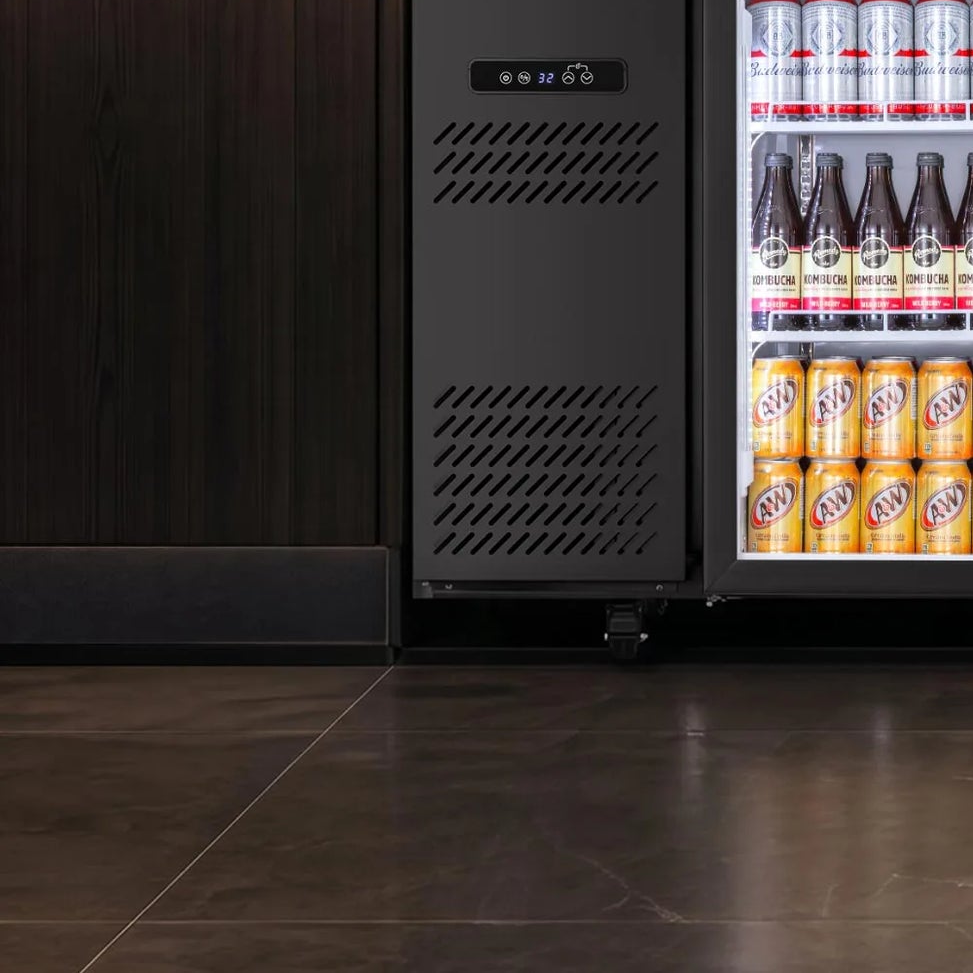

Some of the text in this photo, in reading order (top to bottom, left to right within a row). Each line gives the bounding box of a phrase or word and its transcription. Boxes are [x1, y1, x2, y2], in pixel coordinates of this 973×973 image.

[538, 72, 554, 84] 32
[752, 274, 796, 286] KOMBUCHA
[803, 273, 847, 285] KOMBUCHA
[854, 274, 898, 286] KOMBUCHA
[905, 273, 949, 284] KOMBUCHA
